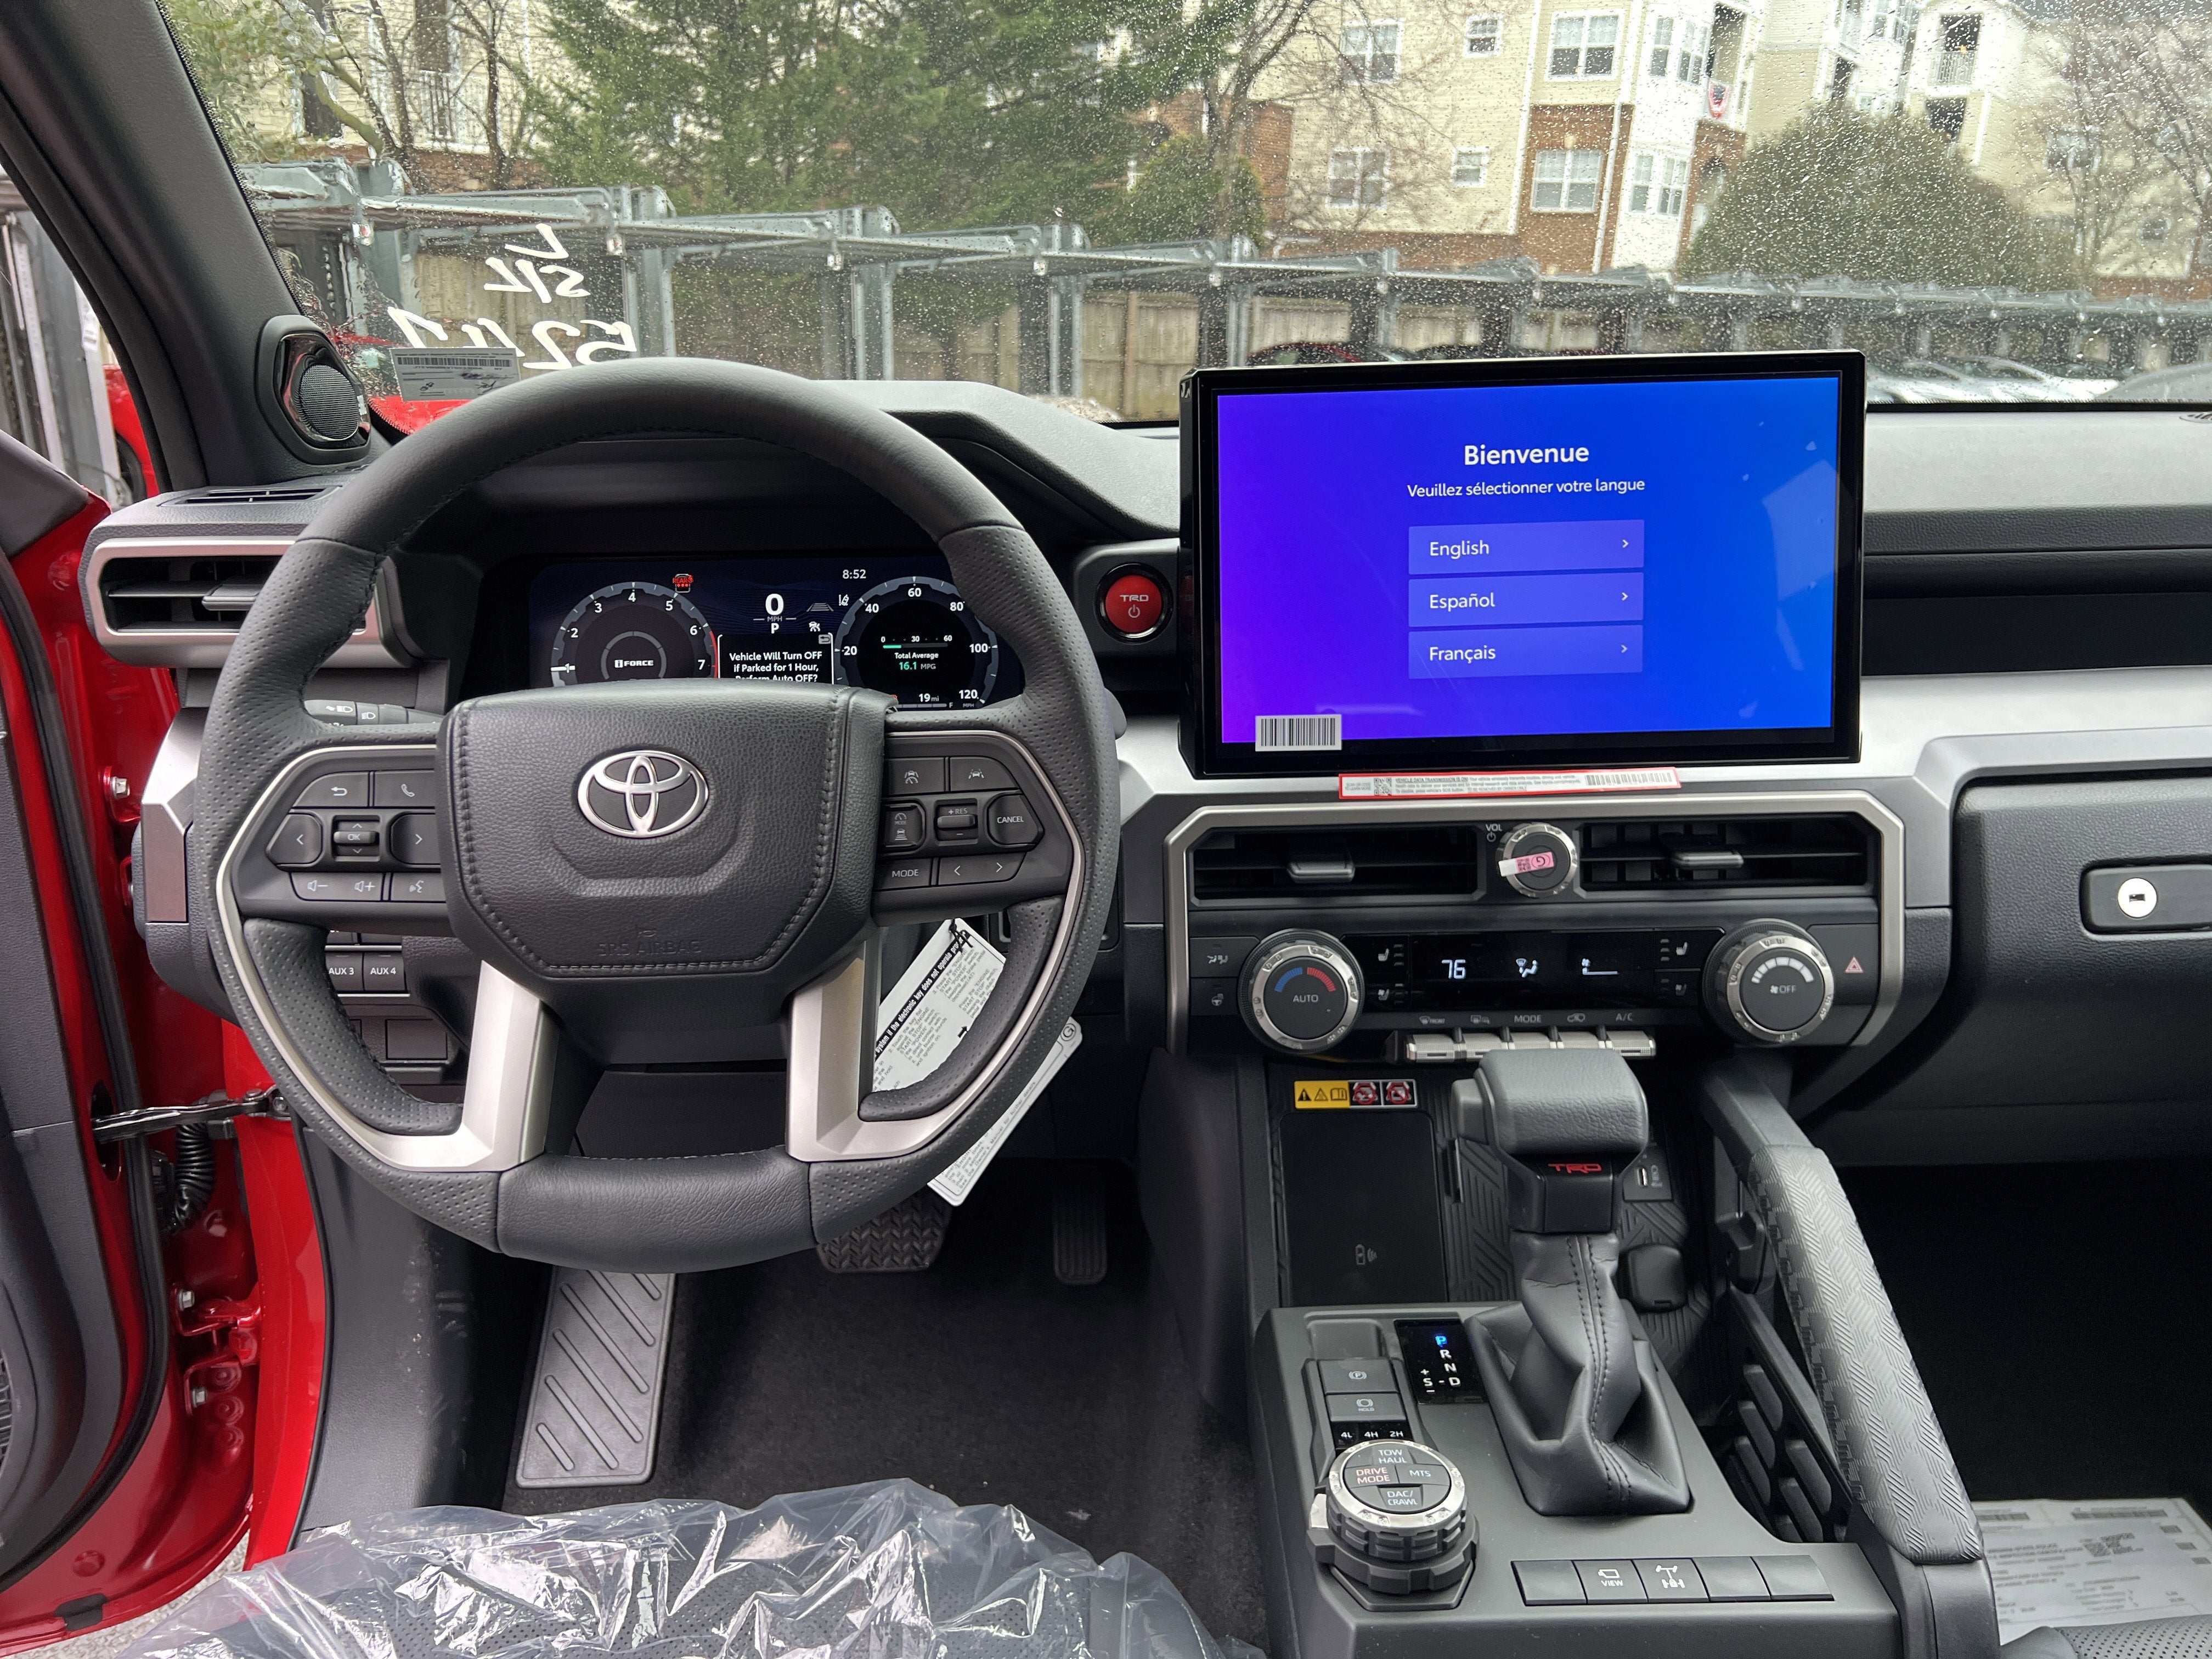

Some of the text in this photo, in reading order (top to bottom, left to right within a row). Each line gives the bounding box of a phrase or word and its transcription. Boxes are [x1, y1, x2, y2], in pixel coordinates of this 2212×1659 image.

[1464, 444, 1589, 466] Bienvenue
[1407, 478, 1645, 497] Veuillez sélectionner votre langue
[1430, 540, 1489, 559] English
[842, 569, 866, 579] 8:52
[628, 592, 636, 602] 4
[908, 588, 922, 597] 60
[665, 601, 673, 611] 5
[765, 593, 784, 616] 0
[950, 601, 963, 611] 80
[1429, 592, 1496, 612] Español
[595, 603, 602, 613] 3
[865, 603, 879, 613] 40
[571, 628, 578, 637] 2
[690, 625, 698, 635] 6
[771, 623, 779, 634] P
[844, 646, 857, 656] 20
[969, 644, 988, 653] 100
[729, 651, 822, 661] Vehicle Will Turn OFF
[1429, 645, 1496, 663] Français
[698, 659, 705, 669] 7
[733, 663, 819, 672] if Parked for 1 Hour,
[899, 662, 917, 670] 16.1
[795, 674, 817, 682] OFF?
[919, 693, 930, 702] 19
[959, 690, 978, 699] 120
[1486, 823, 1502, 832] VOL
[892, 869, 919, 878] MODE
[1441, 959, 1466, 979] 76
[890, 1020, 900, 1031] the
[896, 998, 917, 1023] electronic
[913, 989, 925, 1001] key
[919, 977, 933, 991] does
[929, 968, 940, 979] not
[936, 951, 953, 971] operate
[1780, 985, 1796, 994] OFF
[1293, 994, 1319, 1003] AUTO
[1514, 1014, 1542, 1023] MODE
[1616, 1013, 1633, 1022] A/C
[1547, 1162, 1602, 1174] TRD
[1435, 1335, 1448, 1347] P
[1440, 1350, 1452, 1359] R
[1444, 1363, 1457, 1372] N
[1423, 1377, 1460, 1386] S D
[1356, 1467, 1388, 1476] DRIVE
[1357, 1475, 1391, 1485] MODE
